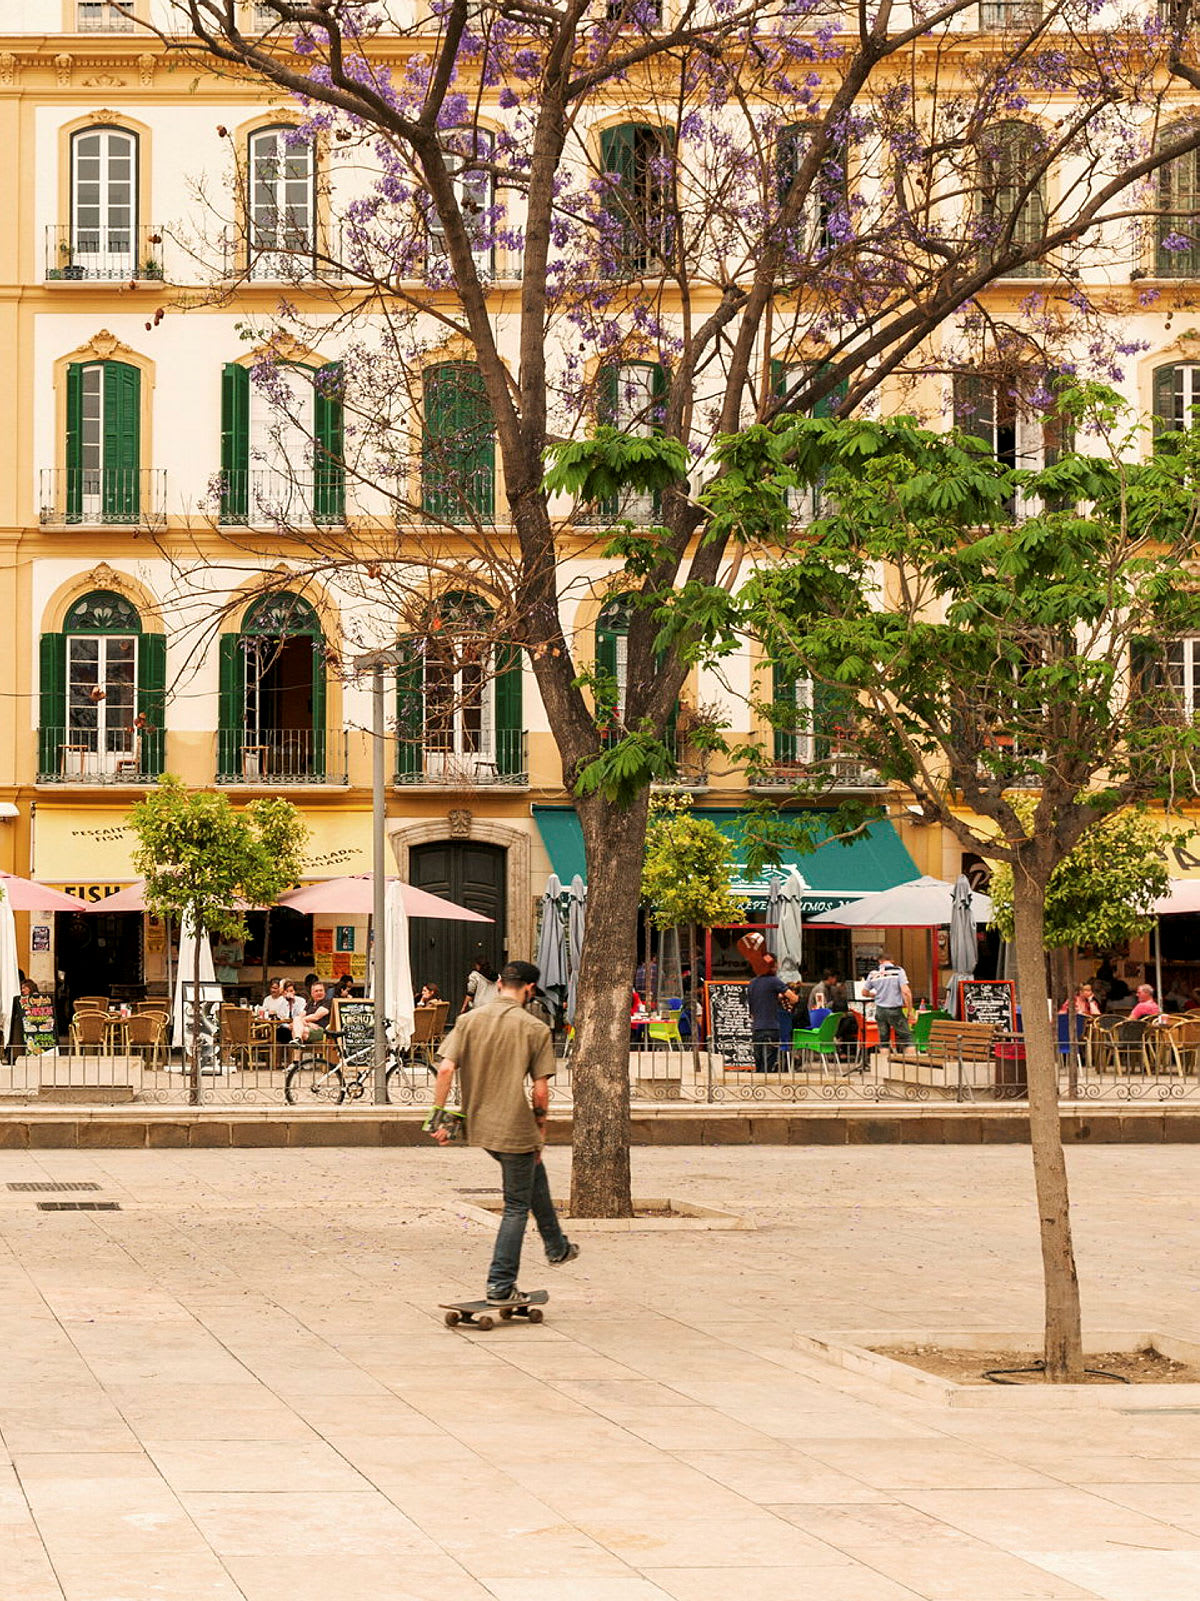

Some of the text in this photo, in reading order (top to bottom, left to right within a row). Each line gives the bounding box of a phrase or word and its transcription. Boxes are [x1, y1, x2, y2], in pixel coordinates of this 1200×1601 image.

[96, 834, 123, 842] FISH
[302, 856, 351, 868] SALADS
[65, 886, 120, 903] FISH
